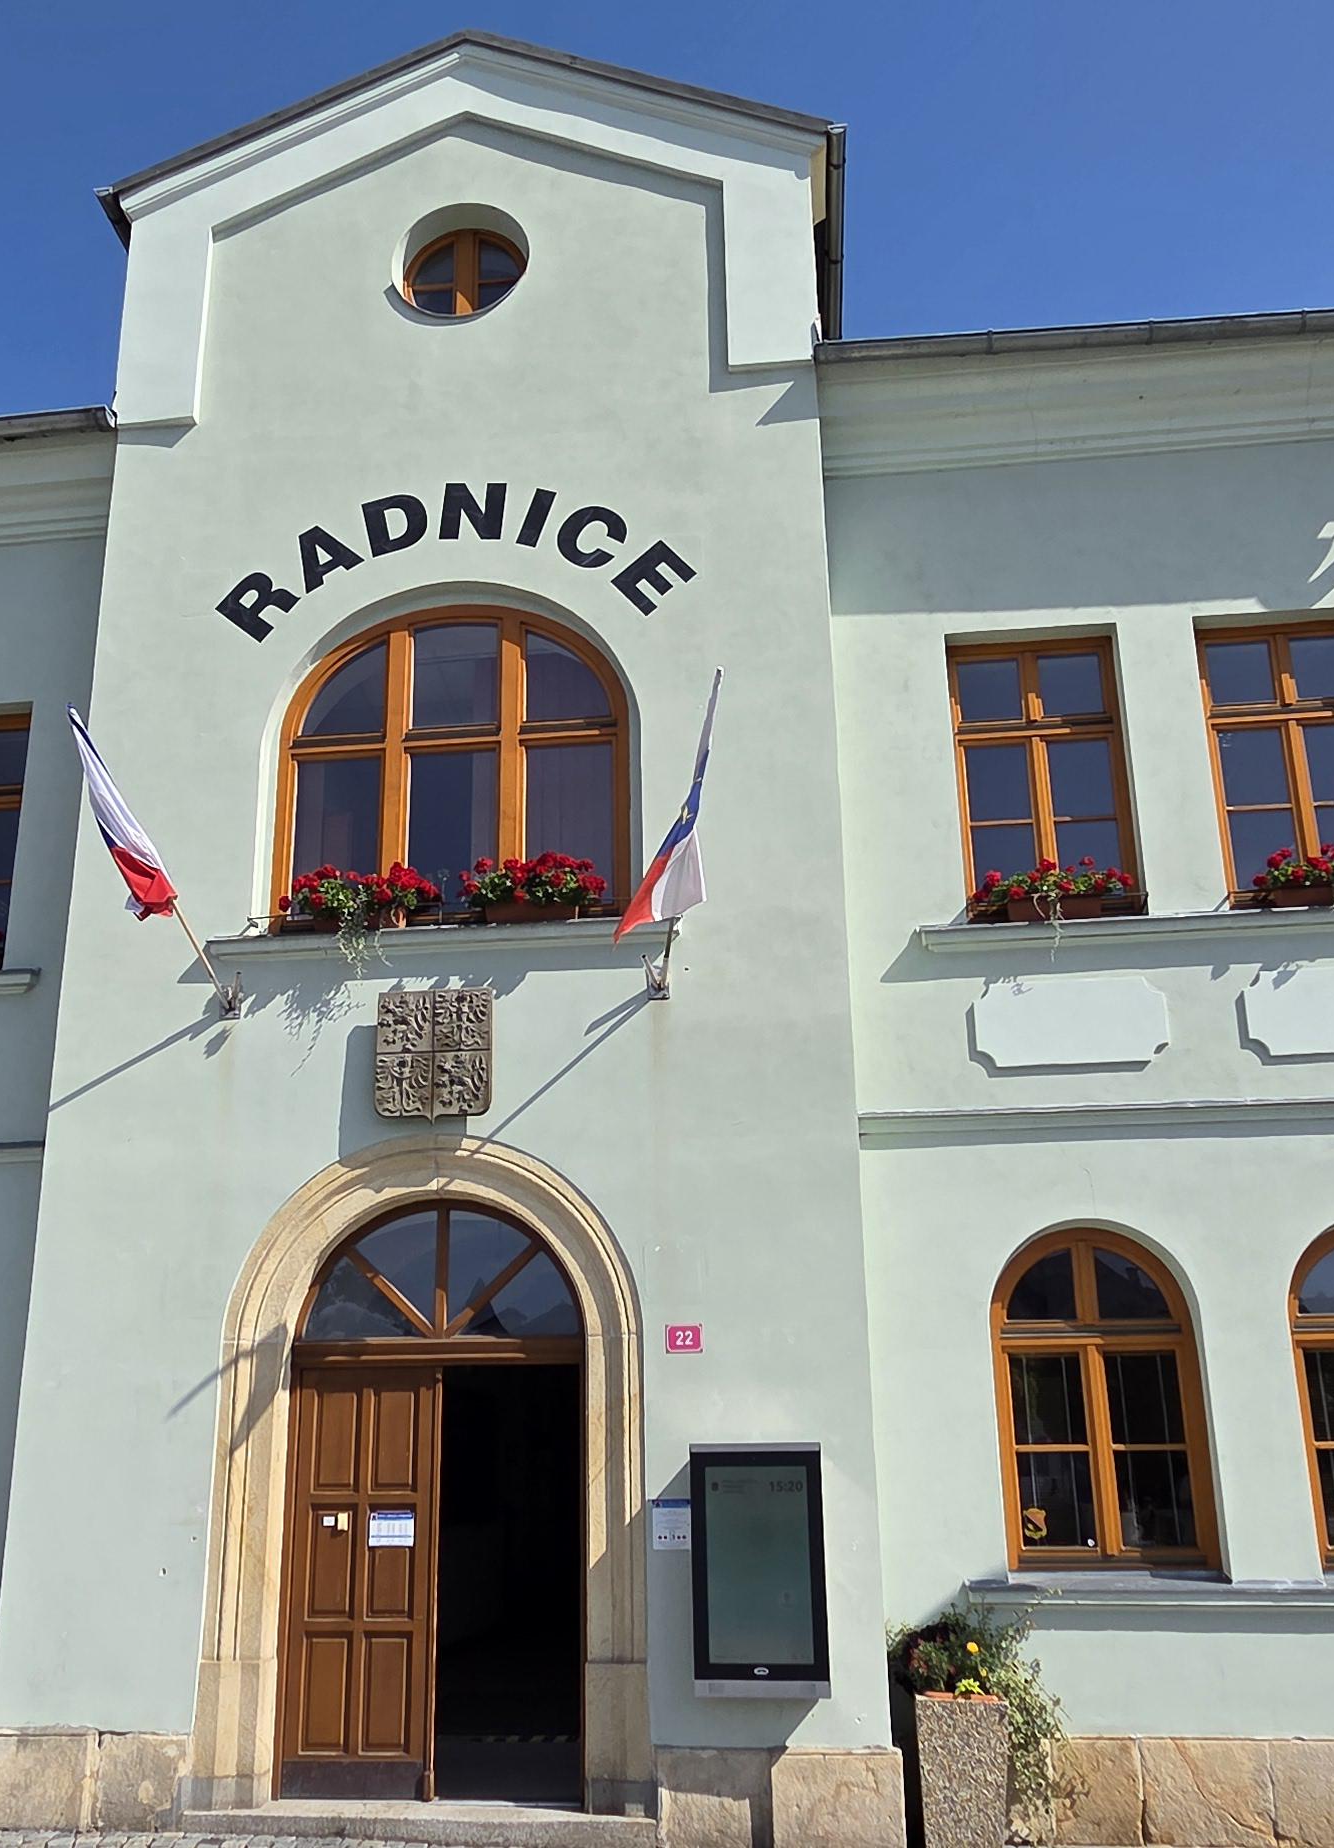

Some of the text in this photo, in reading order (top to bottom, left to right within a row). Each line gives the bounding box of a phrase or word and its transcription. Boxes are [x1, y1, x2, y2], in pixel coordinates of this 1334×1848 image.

[214, 481, 698, 644] RADNICE
[675, 1330, 694, 1346] 22
[769, 1481, 804, 1493] 15:20
